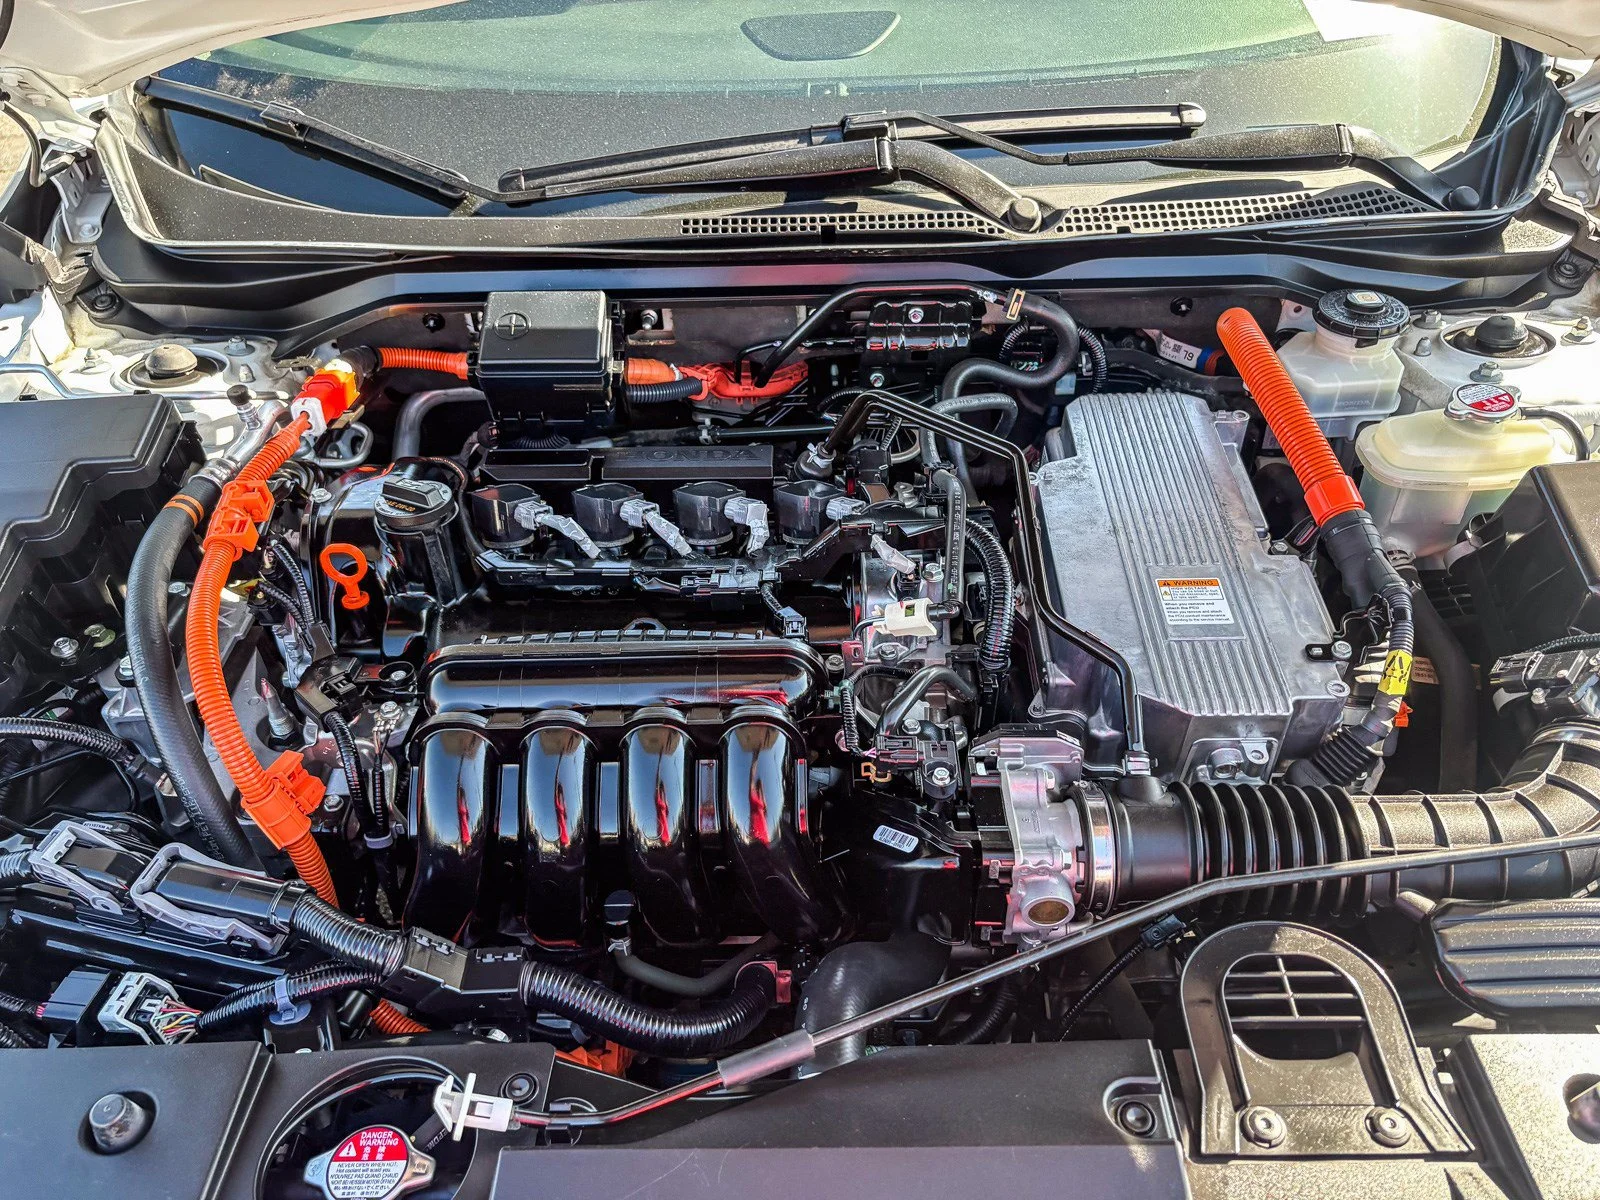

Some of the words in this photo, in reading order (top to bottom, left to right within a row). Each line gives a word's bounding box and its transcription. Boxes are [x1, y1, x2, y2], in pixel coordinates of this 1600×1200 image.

[1183, 350, 1194, 361] 79
[361, 1131, 393, 1139] DANGER
[360, 1138, 399, 1146] WARNUNG
